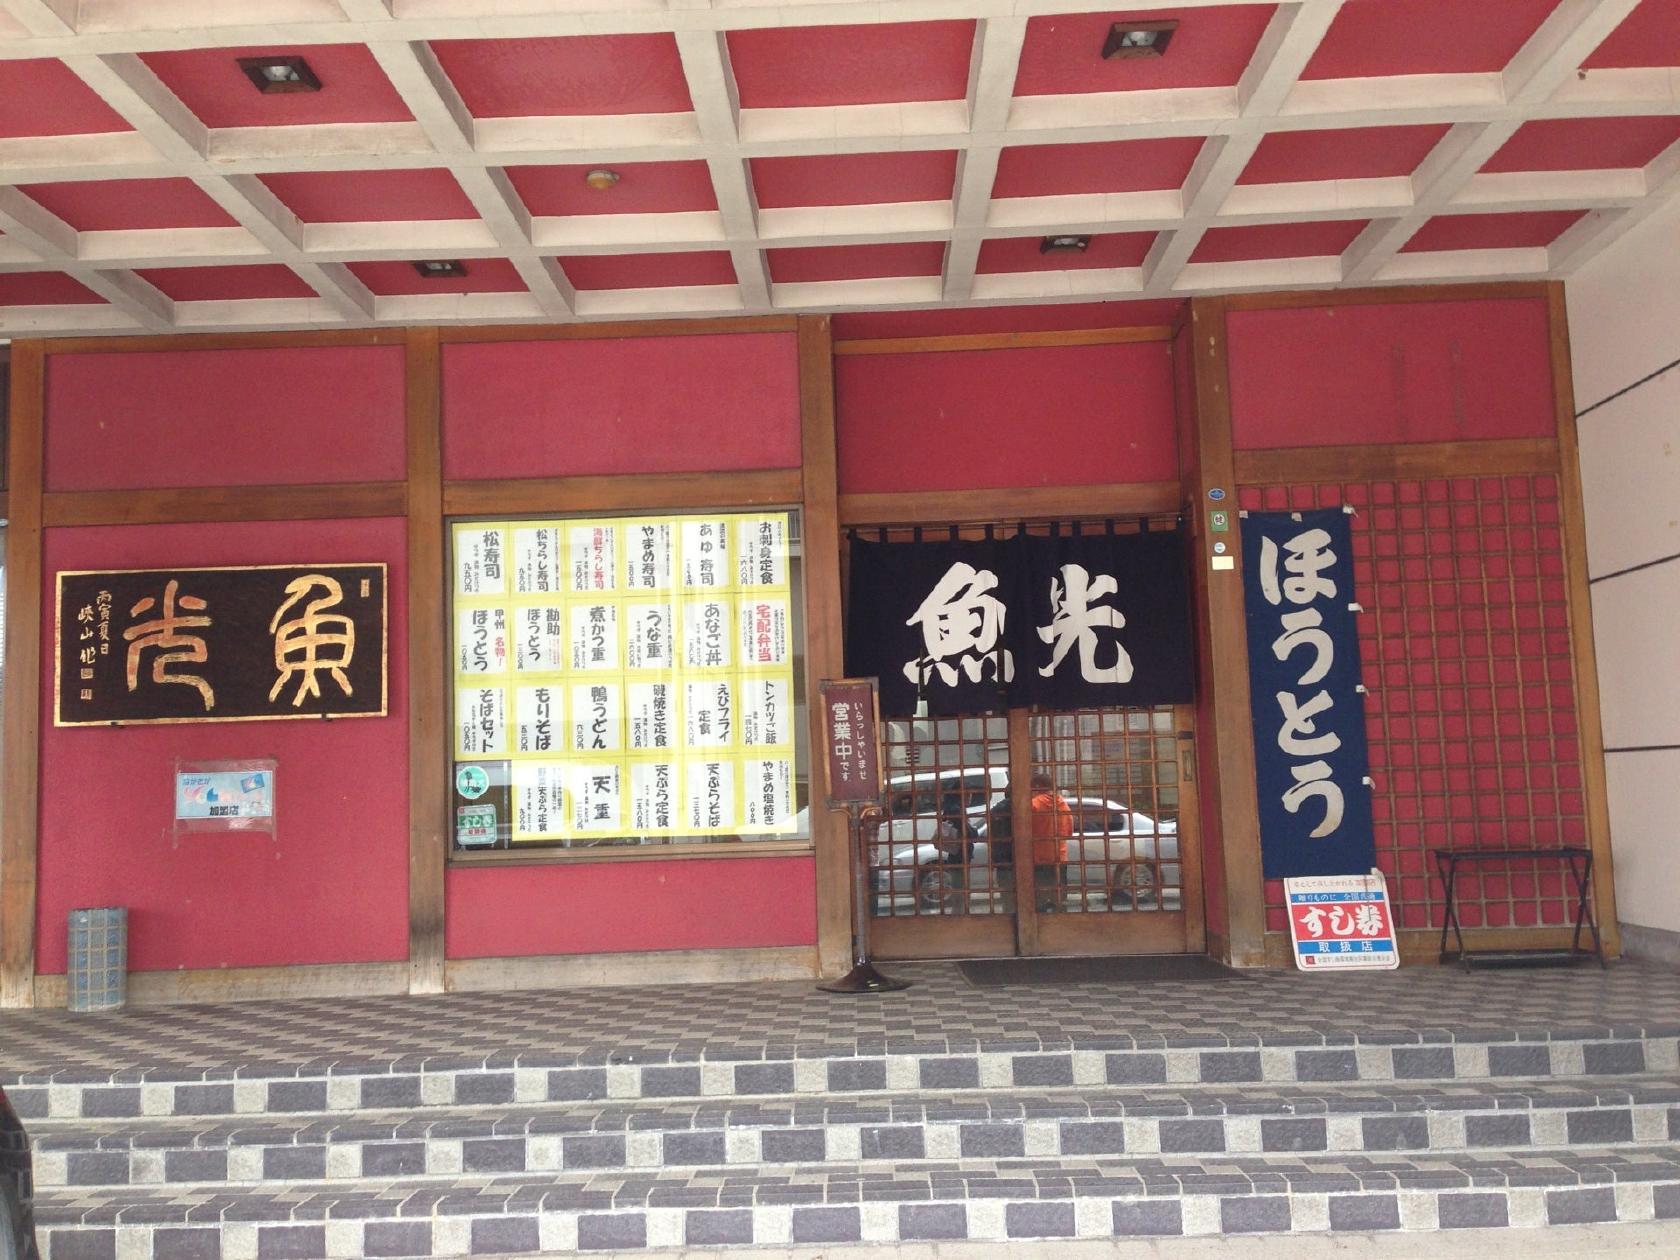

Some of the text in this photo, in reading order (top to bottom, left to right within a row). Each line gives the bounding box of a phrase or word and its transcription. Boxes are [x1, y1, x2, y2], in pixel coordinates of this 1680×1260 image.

[483, 530, 500, 579] 松寿司
[536, 528, 548, 592] 松ちらし寿司
[642, 525, 655, 588] やまめ寿司
[700, 523, 714, 585] あゆ寿司
[760, 521, 773, 584] お刺身定食
[473, 610, 488, 671] ほうとう
[494, 609, 505, 629] 甲州
[527, 608, 541, 661] ほうとう
[546, 608, 560, 635] 勘助
[590, 606, 606, 661] 煮かつ重
[646, 610, 663, 659] うな重
[704, 603, 722, 666] あなご丼
[756, 604, 772, 662] 宅配弁当
[903, 561, 1134, 687] 魚光
[717, 683, 730, 742] えびフライ
[765, 680, 777, 744] トンカツご飯
[1260, 528, 1344, 838] ほうとう
[480, 689, 494, 753] そばセット
[535, 688, 551, 750] もりそば
[591, 686, 607, 749] 鴨うどん
[653, 684, 667, 747] 磯焼き定食
[698, 710, 711, 735] 定食
[832, 702, 852, 781] 営業中です
[592, 775, 611, 820] 天重
[655, 764, 669, 828] 天ぷら定食
[706, 763, 720, 828] 天ぷらそば
[763, 760, 774, 825] やまめ塩焼き
[1299, 904, 1384, 938] すし券
[1319, 941, 1373, 953] 取扱店
